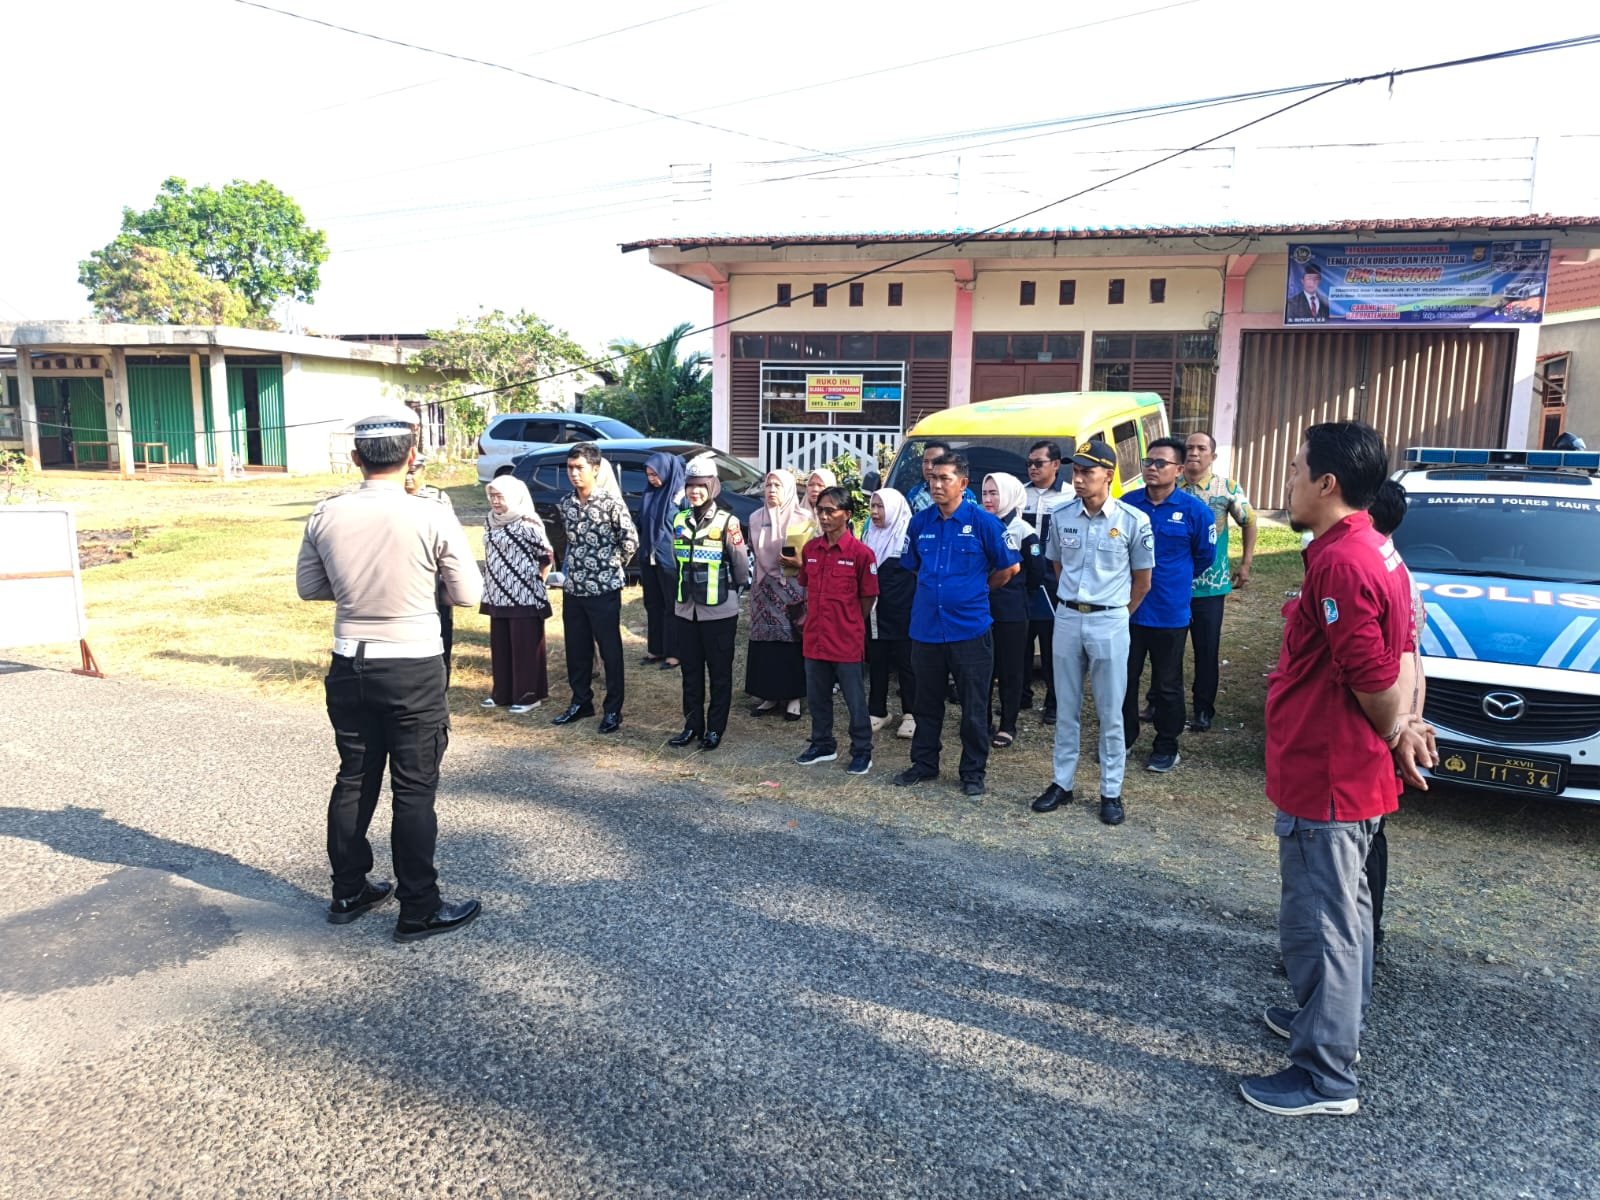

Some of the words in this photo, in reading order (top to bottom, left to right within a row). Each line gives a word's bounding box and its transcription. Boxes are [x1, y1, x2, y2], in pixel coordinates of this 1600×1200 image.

[1327, 256, 1364, 266] LEMBAGA
[1367, 255, 1399, 265] KURSUS
[1420, 254, 1466, 264] PELATIHAN
[1502, 498, 1549, 507] POLRES
[1556, 500, 1591, 511] KAUR
[1505, 759, 1534, 768] XXVII
